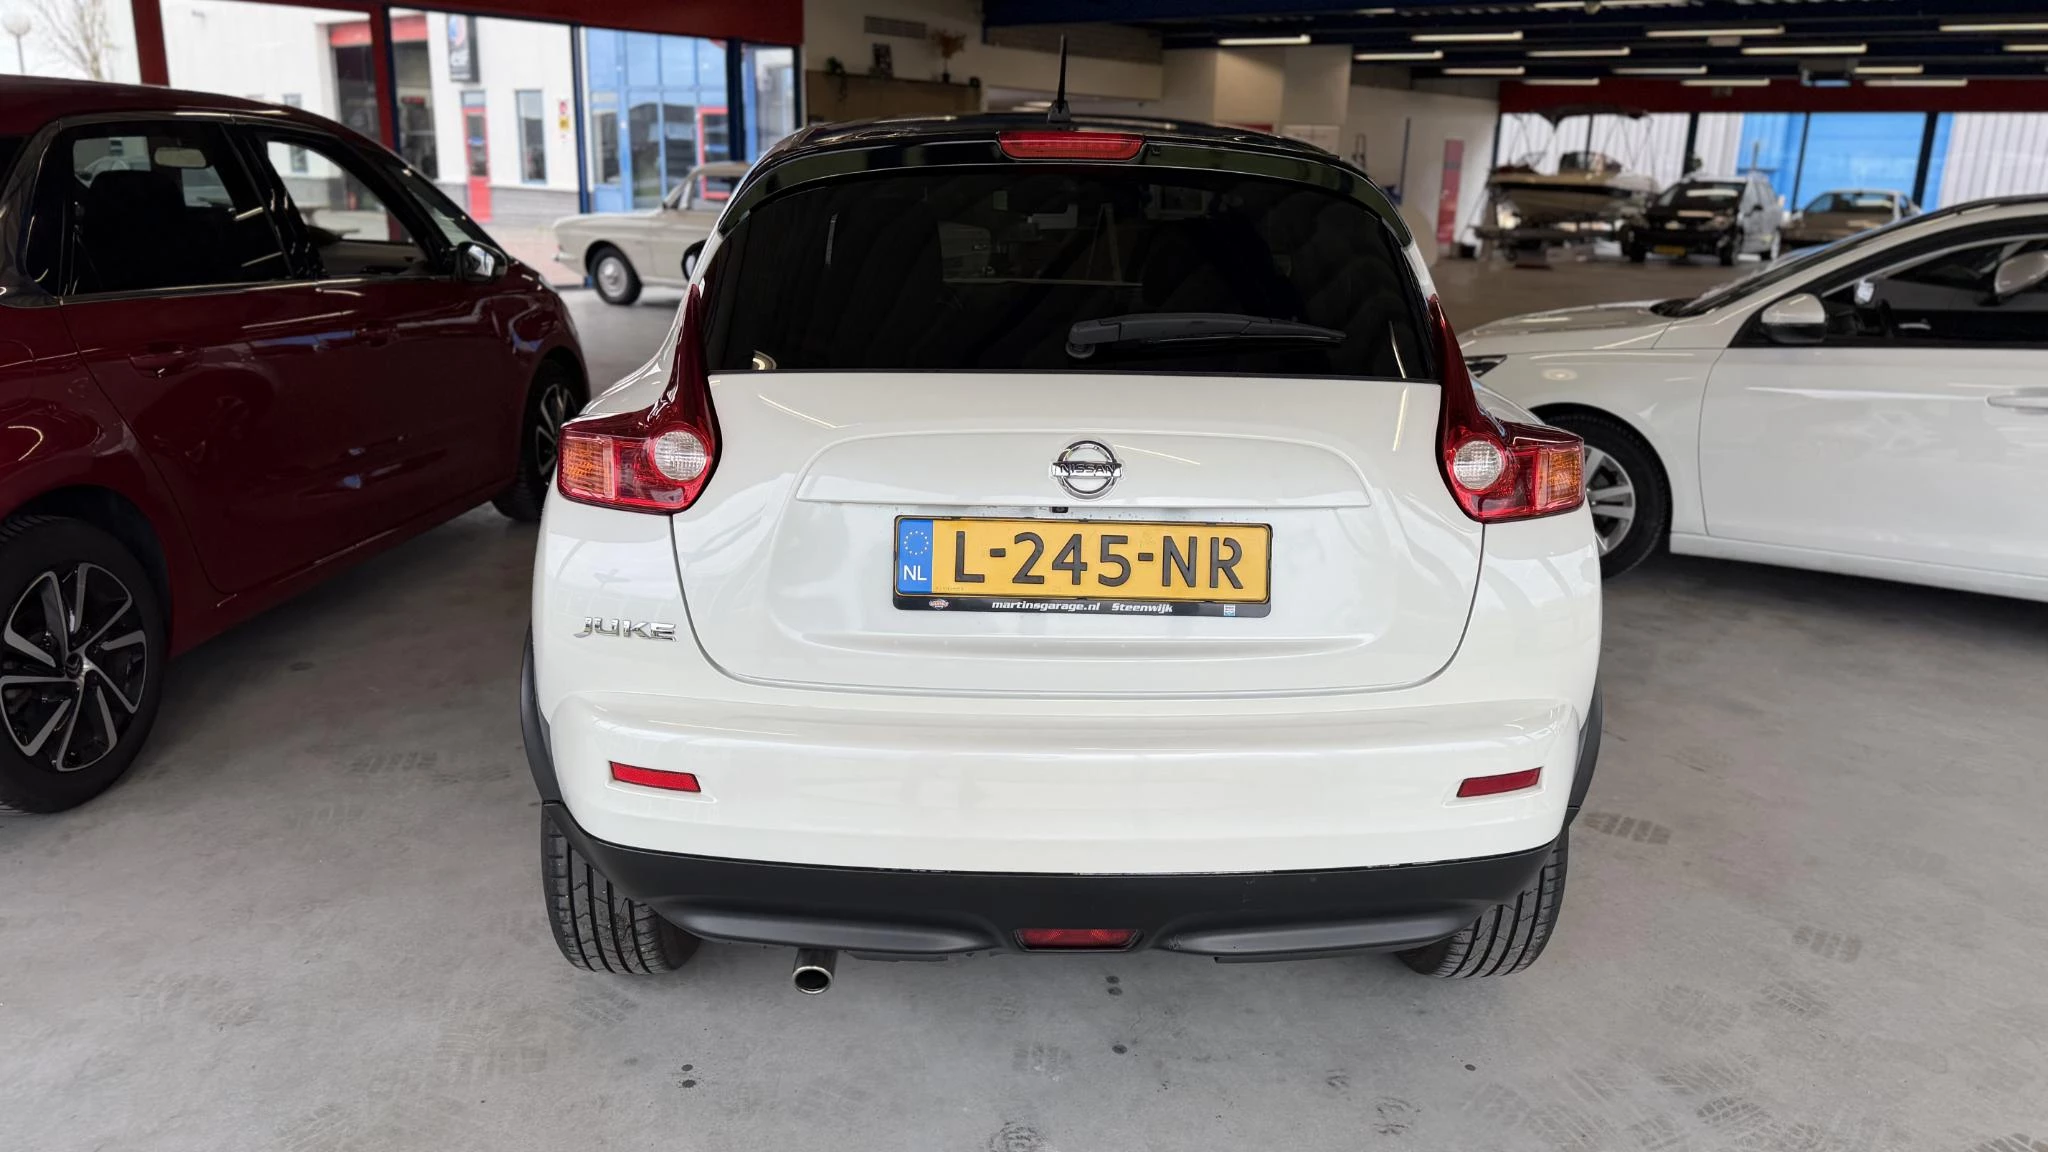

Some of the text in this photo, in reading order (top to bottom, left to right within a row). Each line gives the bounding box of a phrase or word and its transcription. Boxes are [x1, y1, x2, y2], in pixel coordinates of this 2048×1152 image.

[1059, 463, 1116, 475] NISSAN
[954, 530, 1244, 590] L-245-NR
[903, 564, 928, 581] NL
[991, 600, 1174, 614] martinsgarage.nl Steenwijk
[573, 617, 676, 641] JUKE
